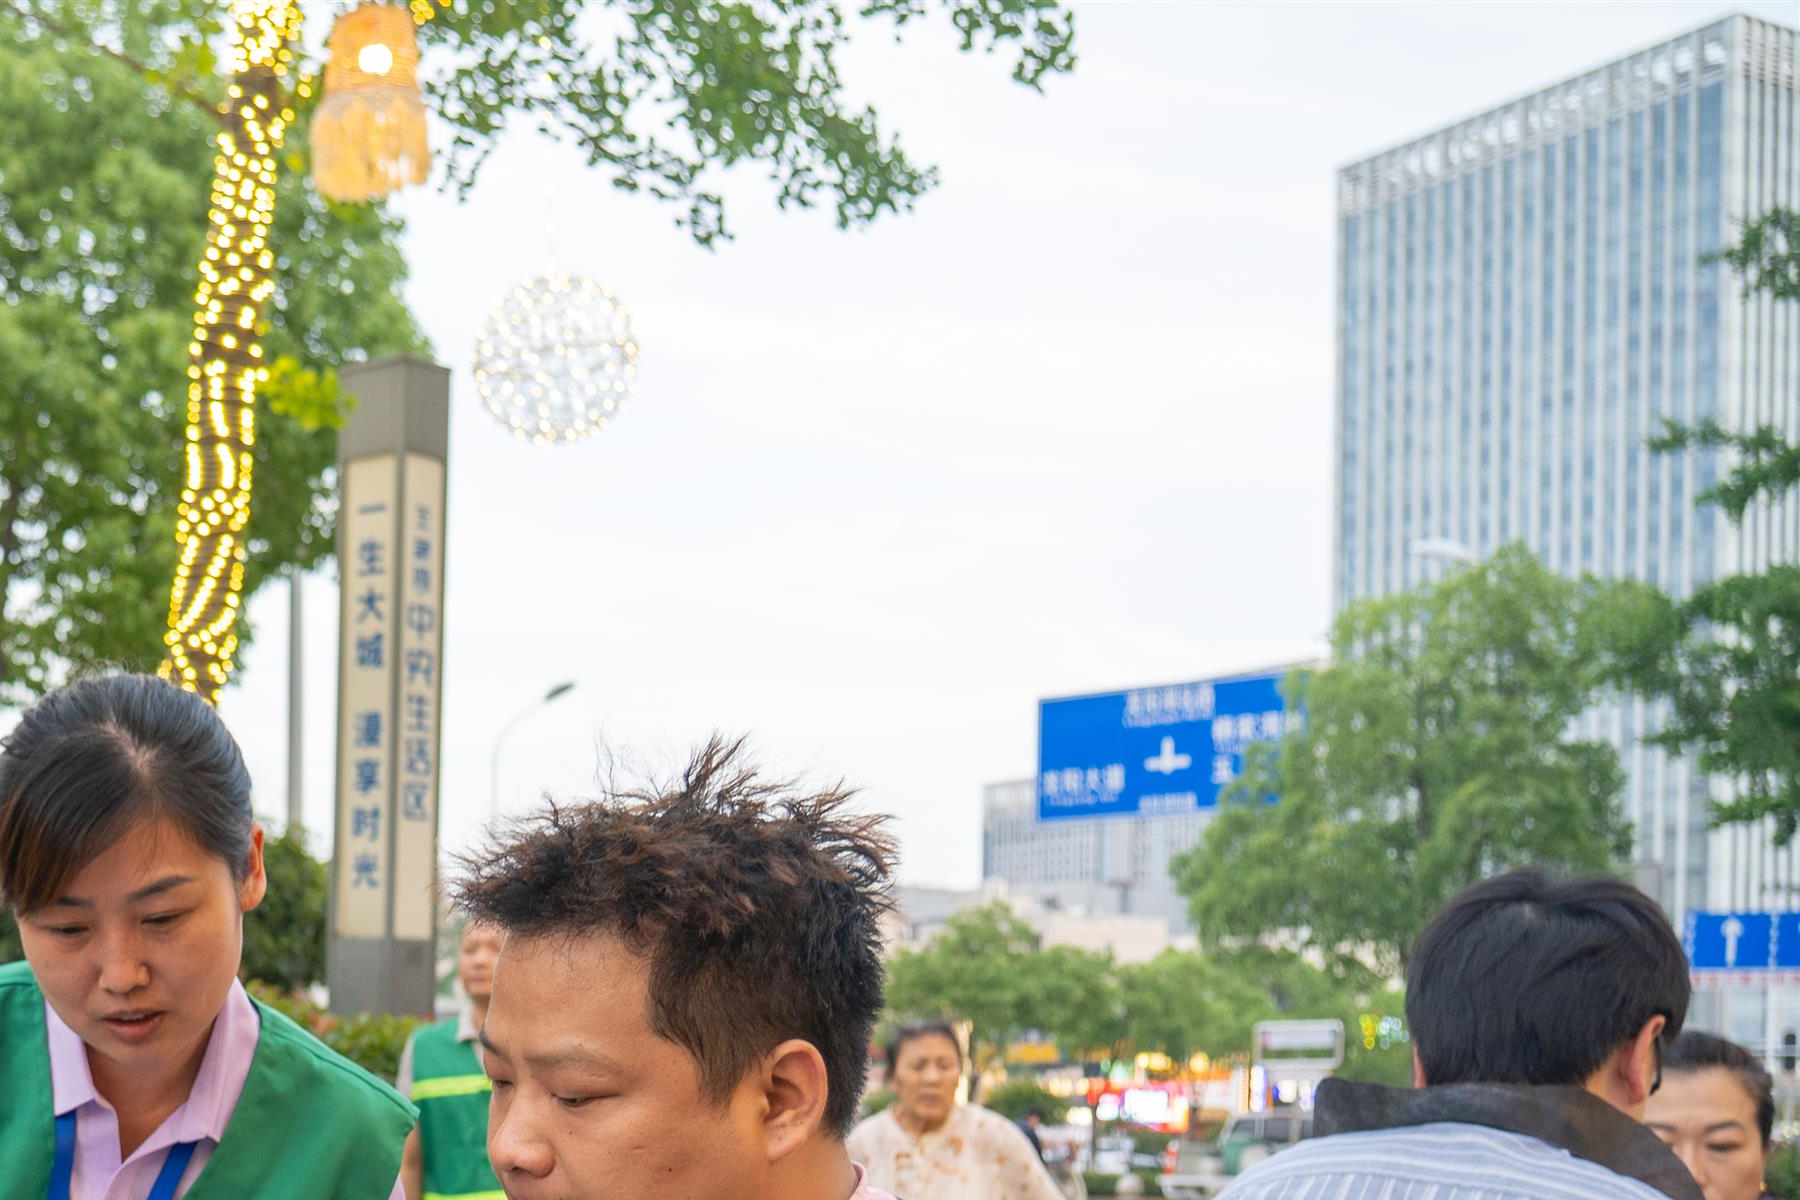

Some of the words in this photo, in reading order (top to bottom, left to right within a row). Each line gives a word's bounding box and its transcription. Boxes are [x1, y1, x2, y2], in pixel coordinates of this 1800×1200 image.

[354, 503, 388, 671] 一生大城
[351, 711, 383, 889] 漫享时光
